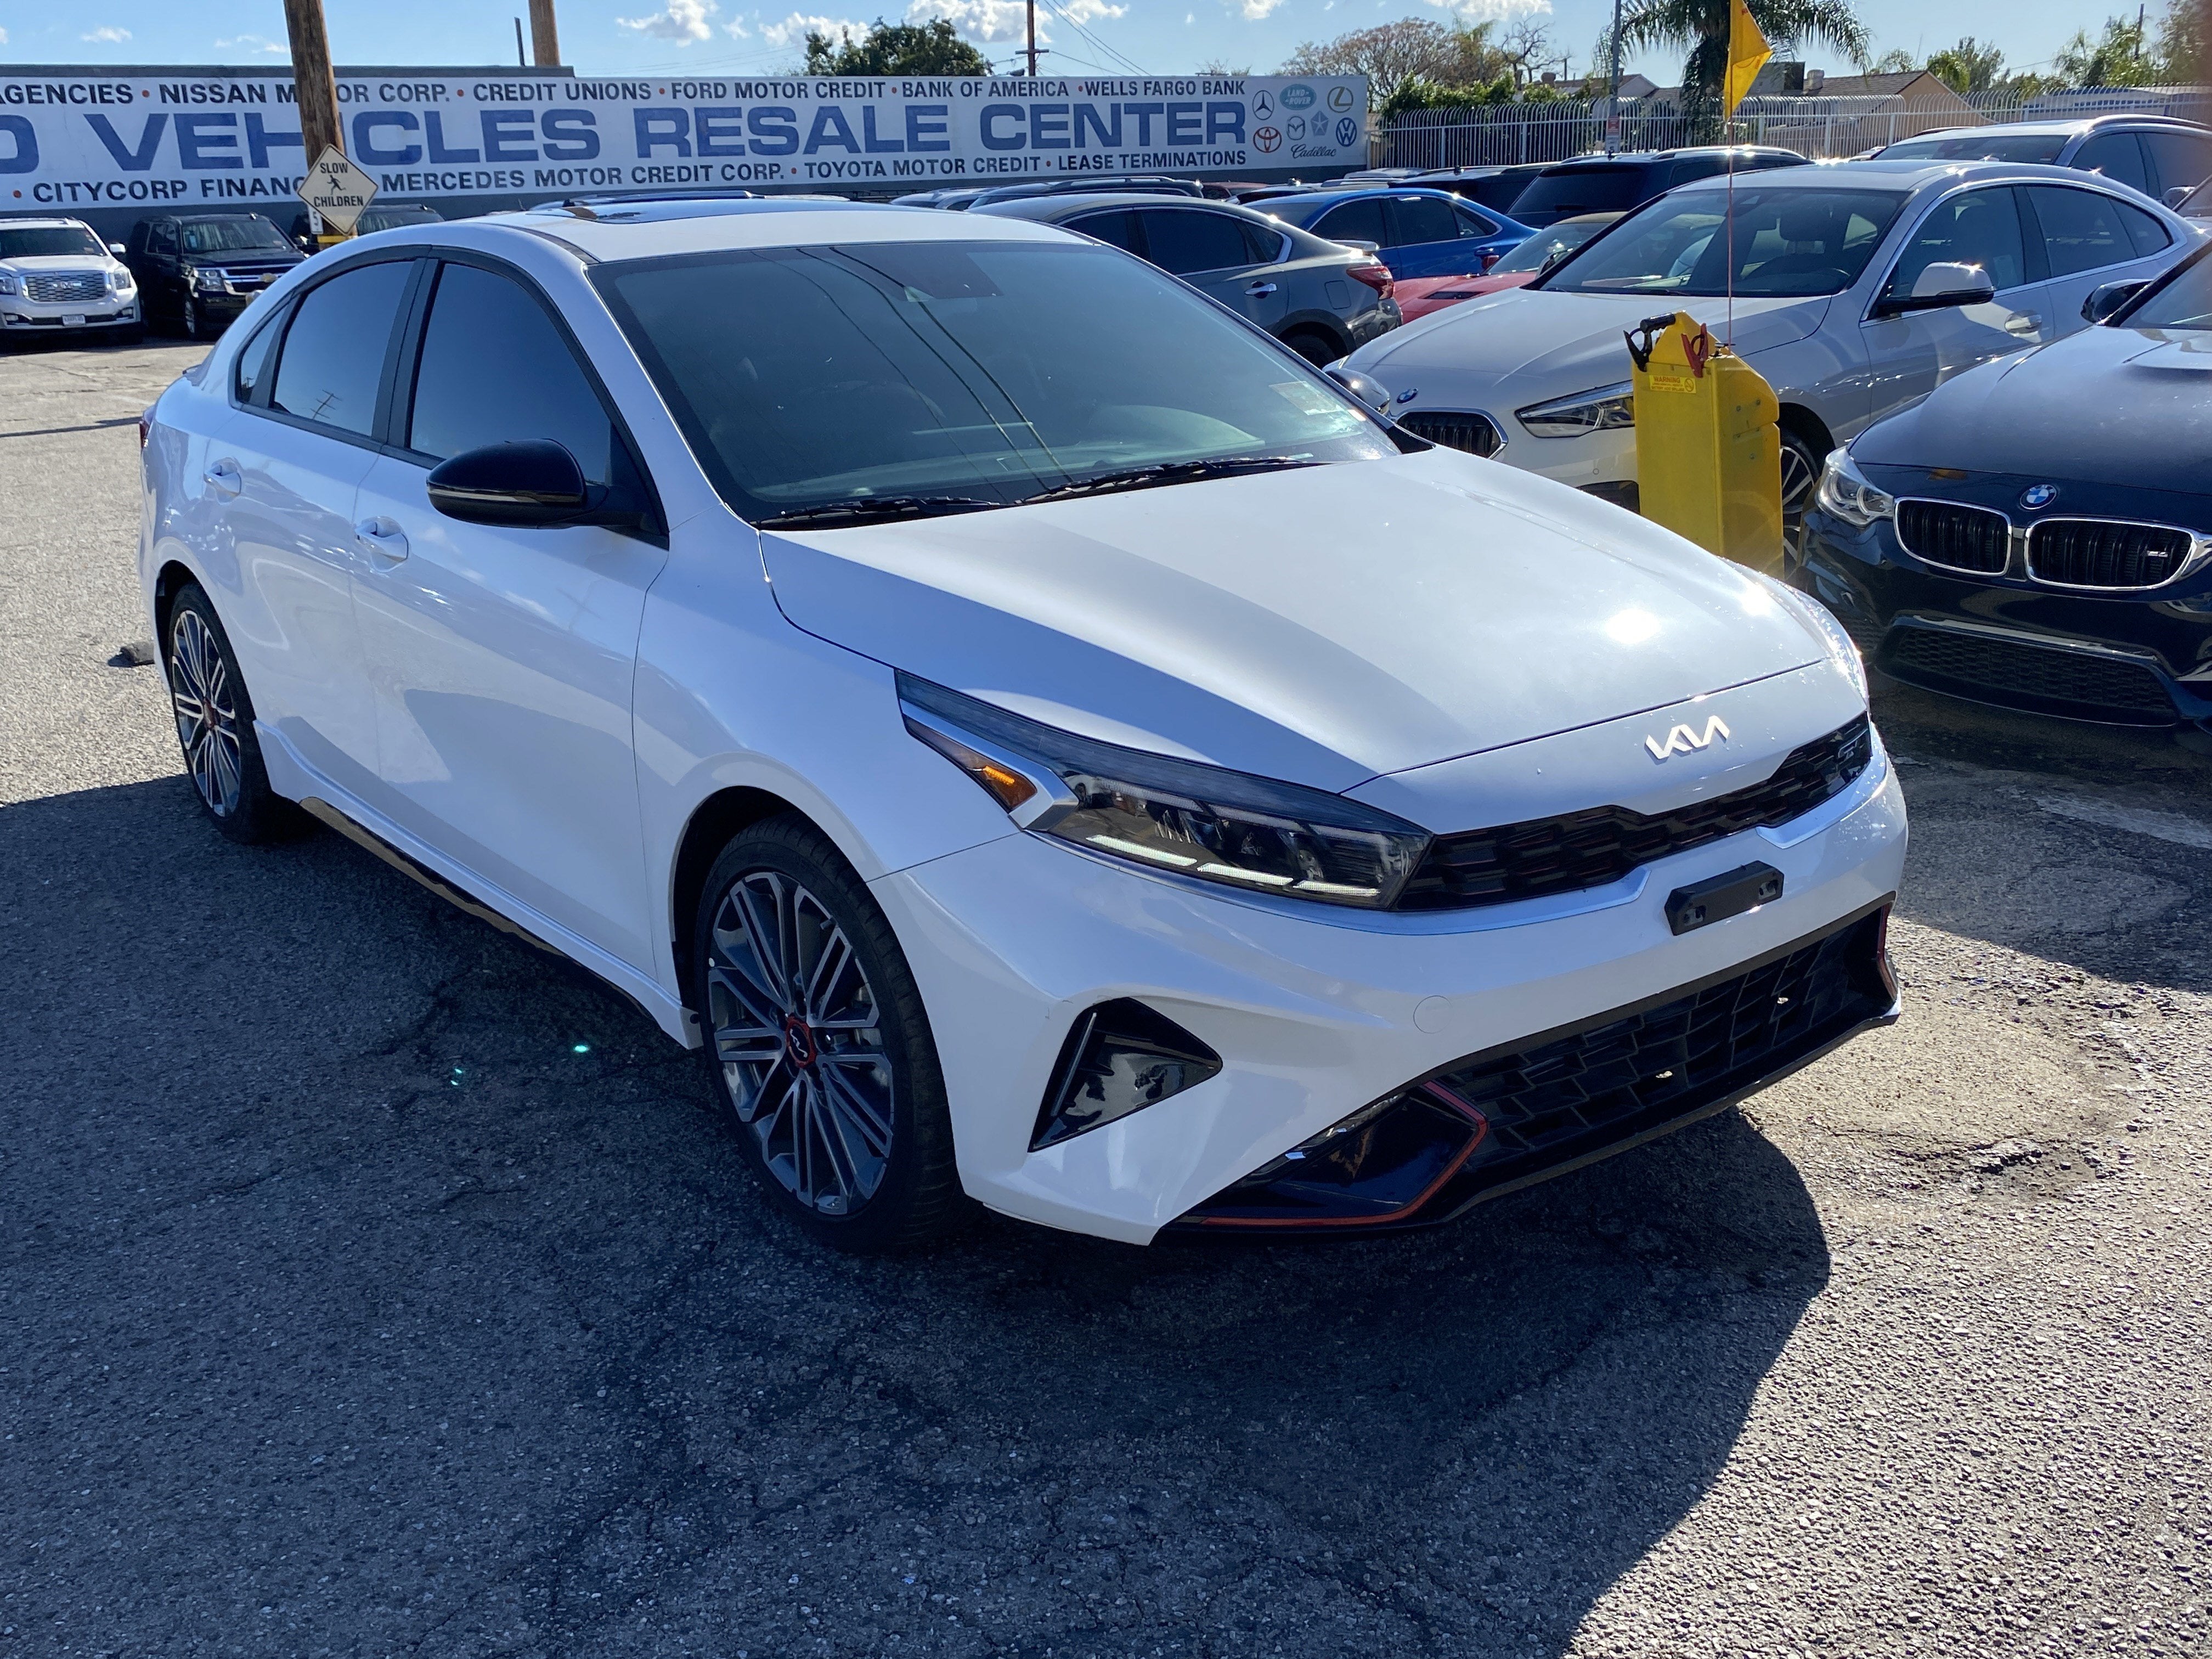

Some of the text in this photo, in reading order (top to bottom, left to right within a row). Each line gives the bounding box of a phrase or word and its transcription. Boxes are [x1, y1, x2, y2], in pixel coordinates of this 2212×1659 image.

[160, 83, 449, 103] NISSAN MOR CORP.
[473, 83, 651, 101] CREDIT UNIONS
[672, 82, 885, 99] FORD MOTOR CREDIT
[902, 82, 1069, 97] BANK OF AMERICA
[1085, 81, 1244, 95] WELLS FARGO BANK
[84, 109, 600, 171] VEHCLES
[634, 105, 950, 157] RESALE
[980, 101, 1245, 150] CENTER
[1059, 151, 1245, 170] LEASE TERMINATIONS
[1291, 144, 1337, 159] Cadillac
[320, 163, 348, 173] SLOW
[804, 156, 1040, 178] TOYOTA MOTOR CREDIT
[382, 163, 783, 191] MERCEDES MOTOR CREDIT CORP.
[33, 180, 187, 202] CITYCORP
[314, 196, 364, 207] CHILDREN
